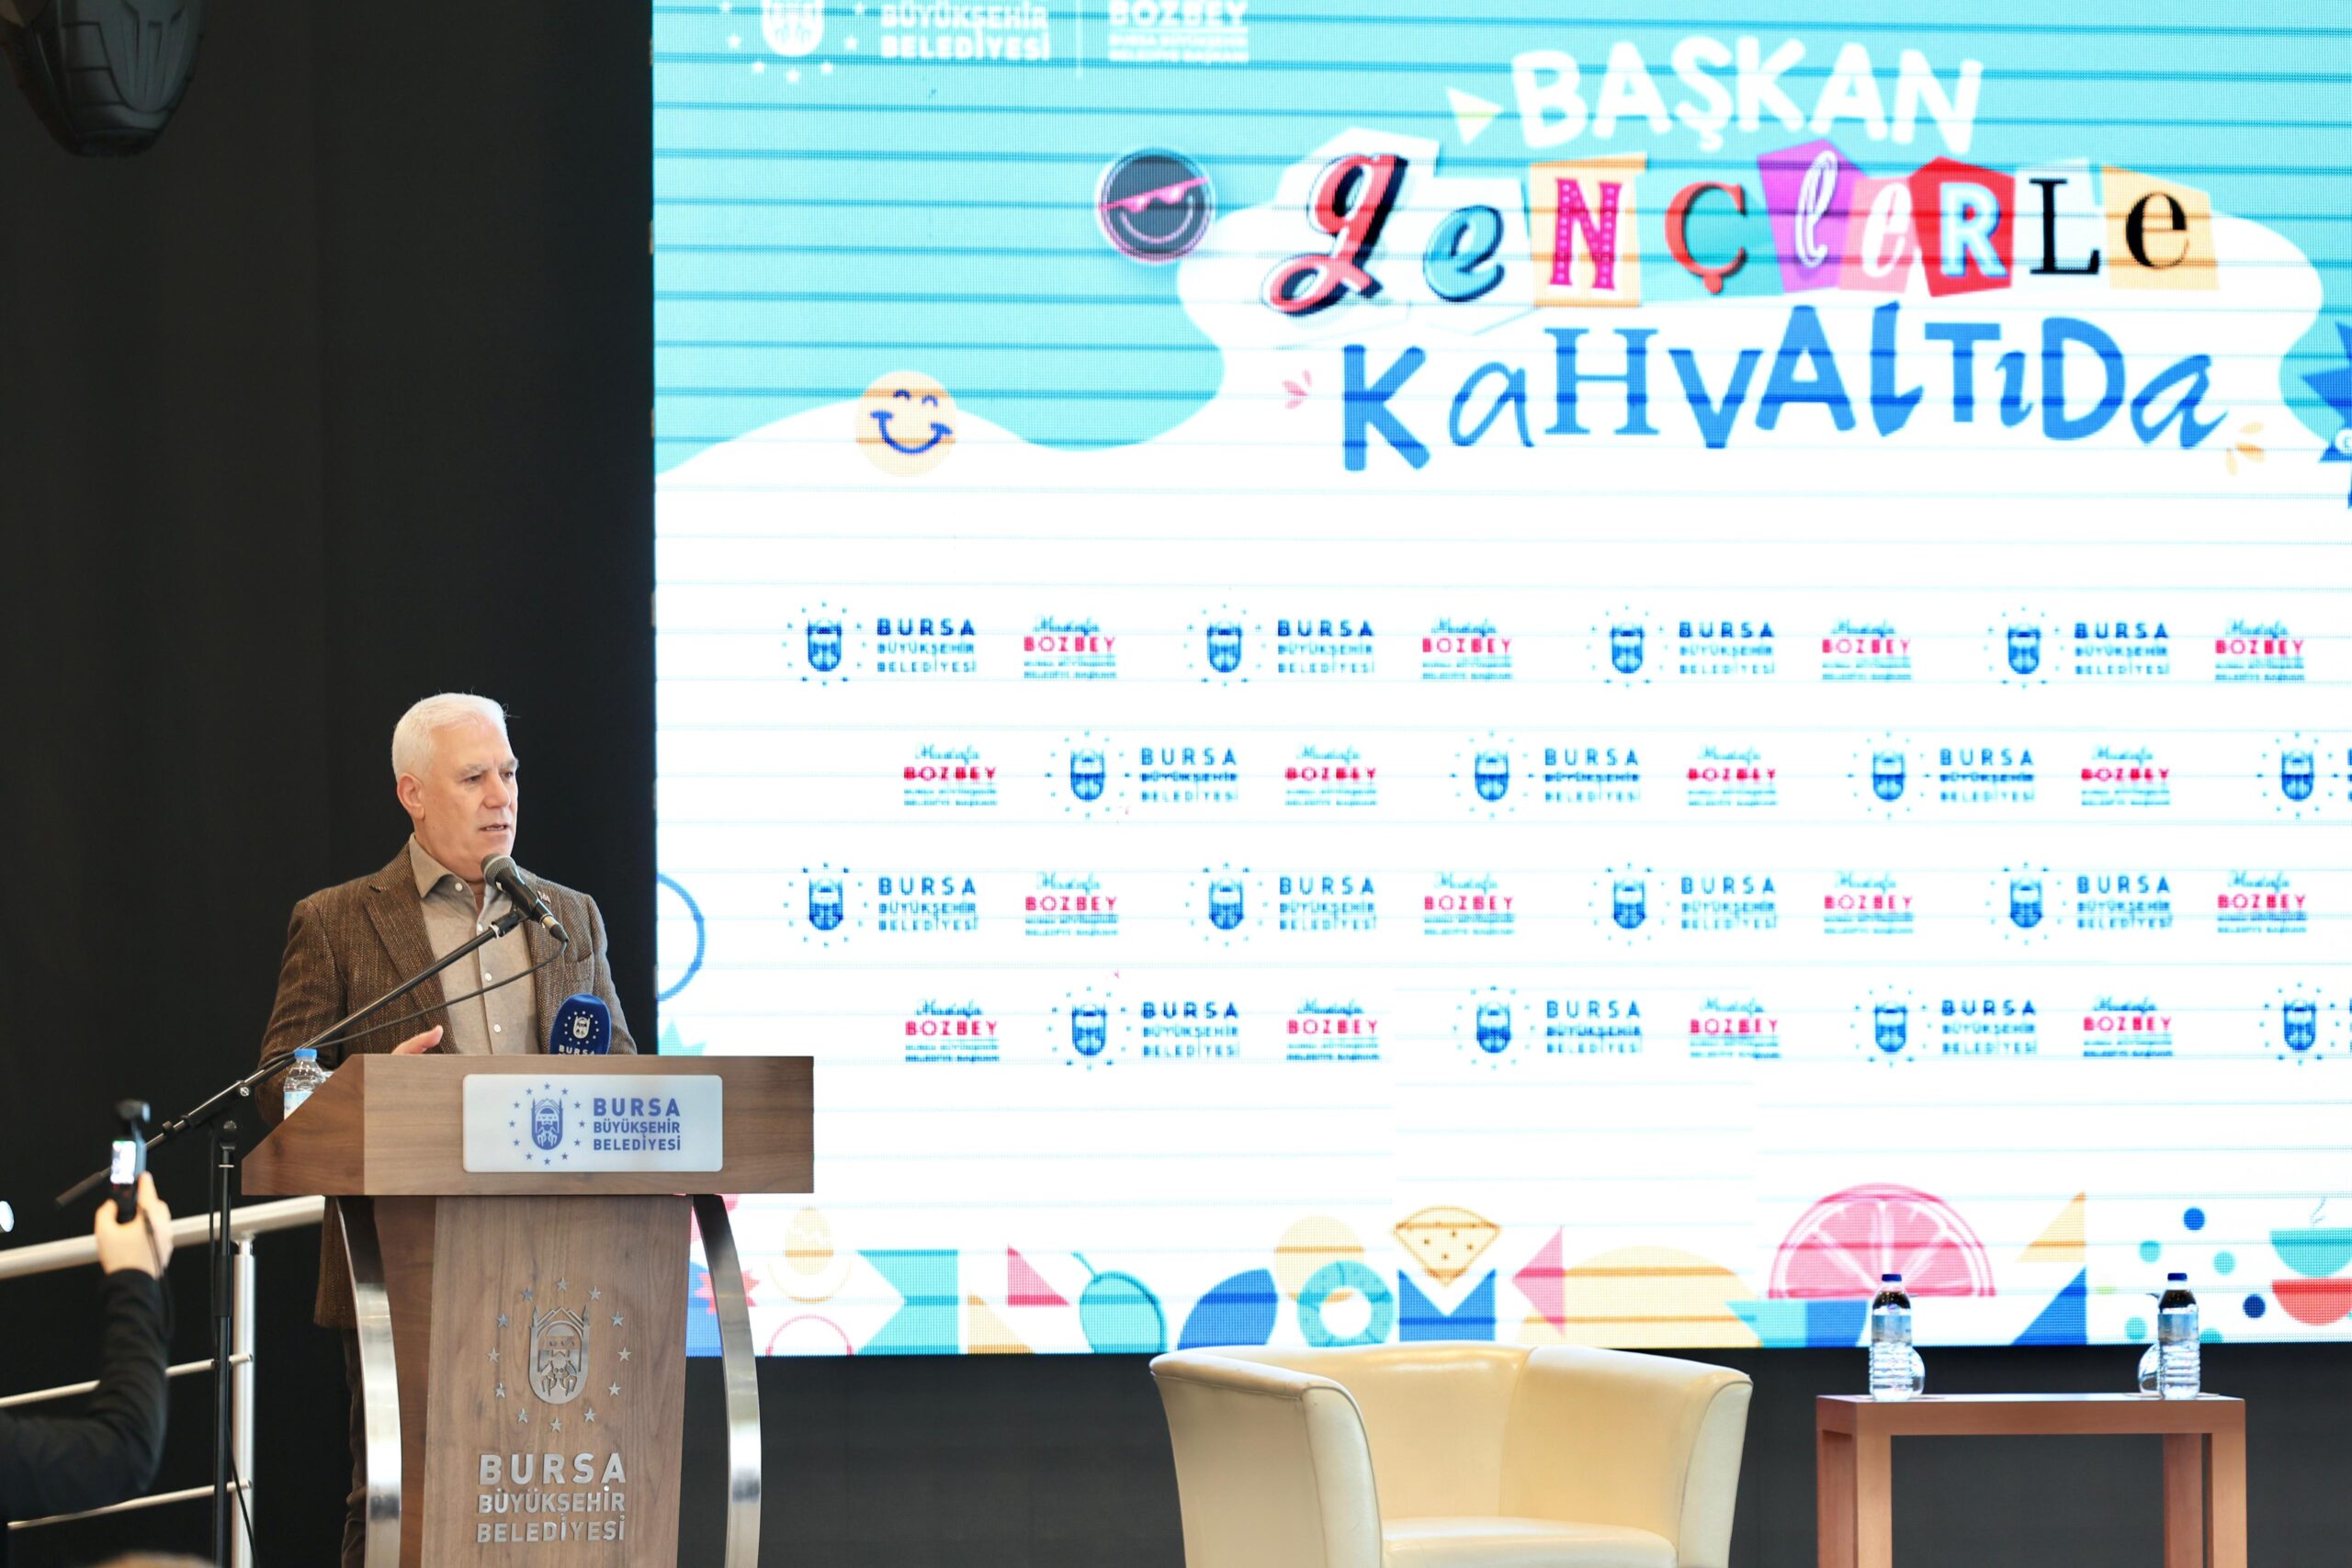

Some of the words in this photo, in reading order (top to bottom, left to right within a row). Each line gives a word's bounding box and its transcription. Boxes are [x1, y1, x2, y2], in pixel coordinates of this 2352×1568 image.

[1511, 36, 1984, 155] BAŞKAN
[876, 617, 976, 637] BURSA
[1277, 619, 1374, 637] BURSA
[1679, 621, 1774, 638] BURSA
[2074, 621, 2169, 640] BURSA
[1140, 747, 1237, 766] BURSA
[1544, 748, 1639, 766] BURSA
[1939, 748, 2033, 766] BURSA
[878, 876, 976, 896] BURSA
[1279, 875, 1374, 896] BURSA
[1681, 875, 1775, 895] BURSA
[2076, 874, 2170, 895] BURSA
[1141, 1001, 1239, 1020] BURSA
[1546, 999, 1641, 1019] BURSA
[1941, 998, 2037, 1017] BURSA
[594, 1098, 681, 1117] BURSA
[594, 1118, 681, 1135] BÜYÜKŞEHİR
[594, 1134, 681, 1151] BELEDİYESİ
[479, 1453, 626, 1485] BURSA
[479, 1485, 625, 1514] BÜYÜKŞEHİR
[477, 1513, 625, 1543] BELEDİYESİ
